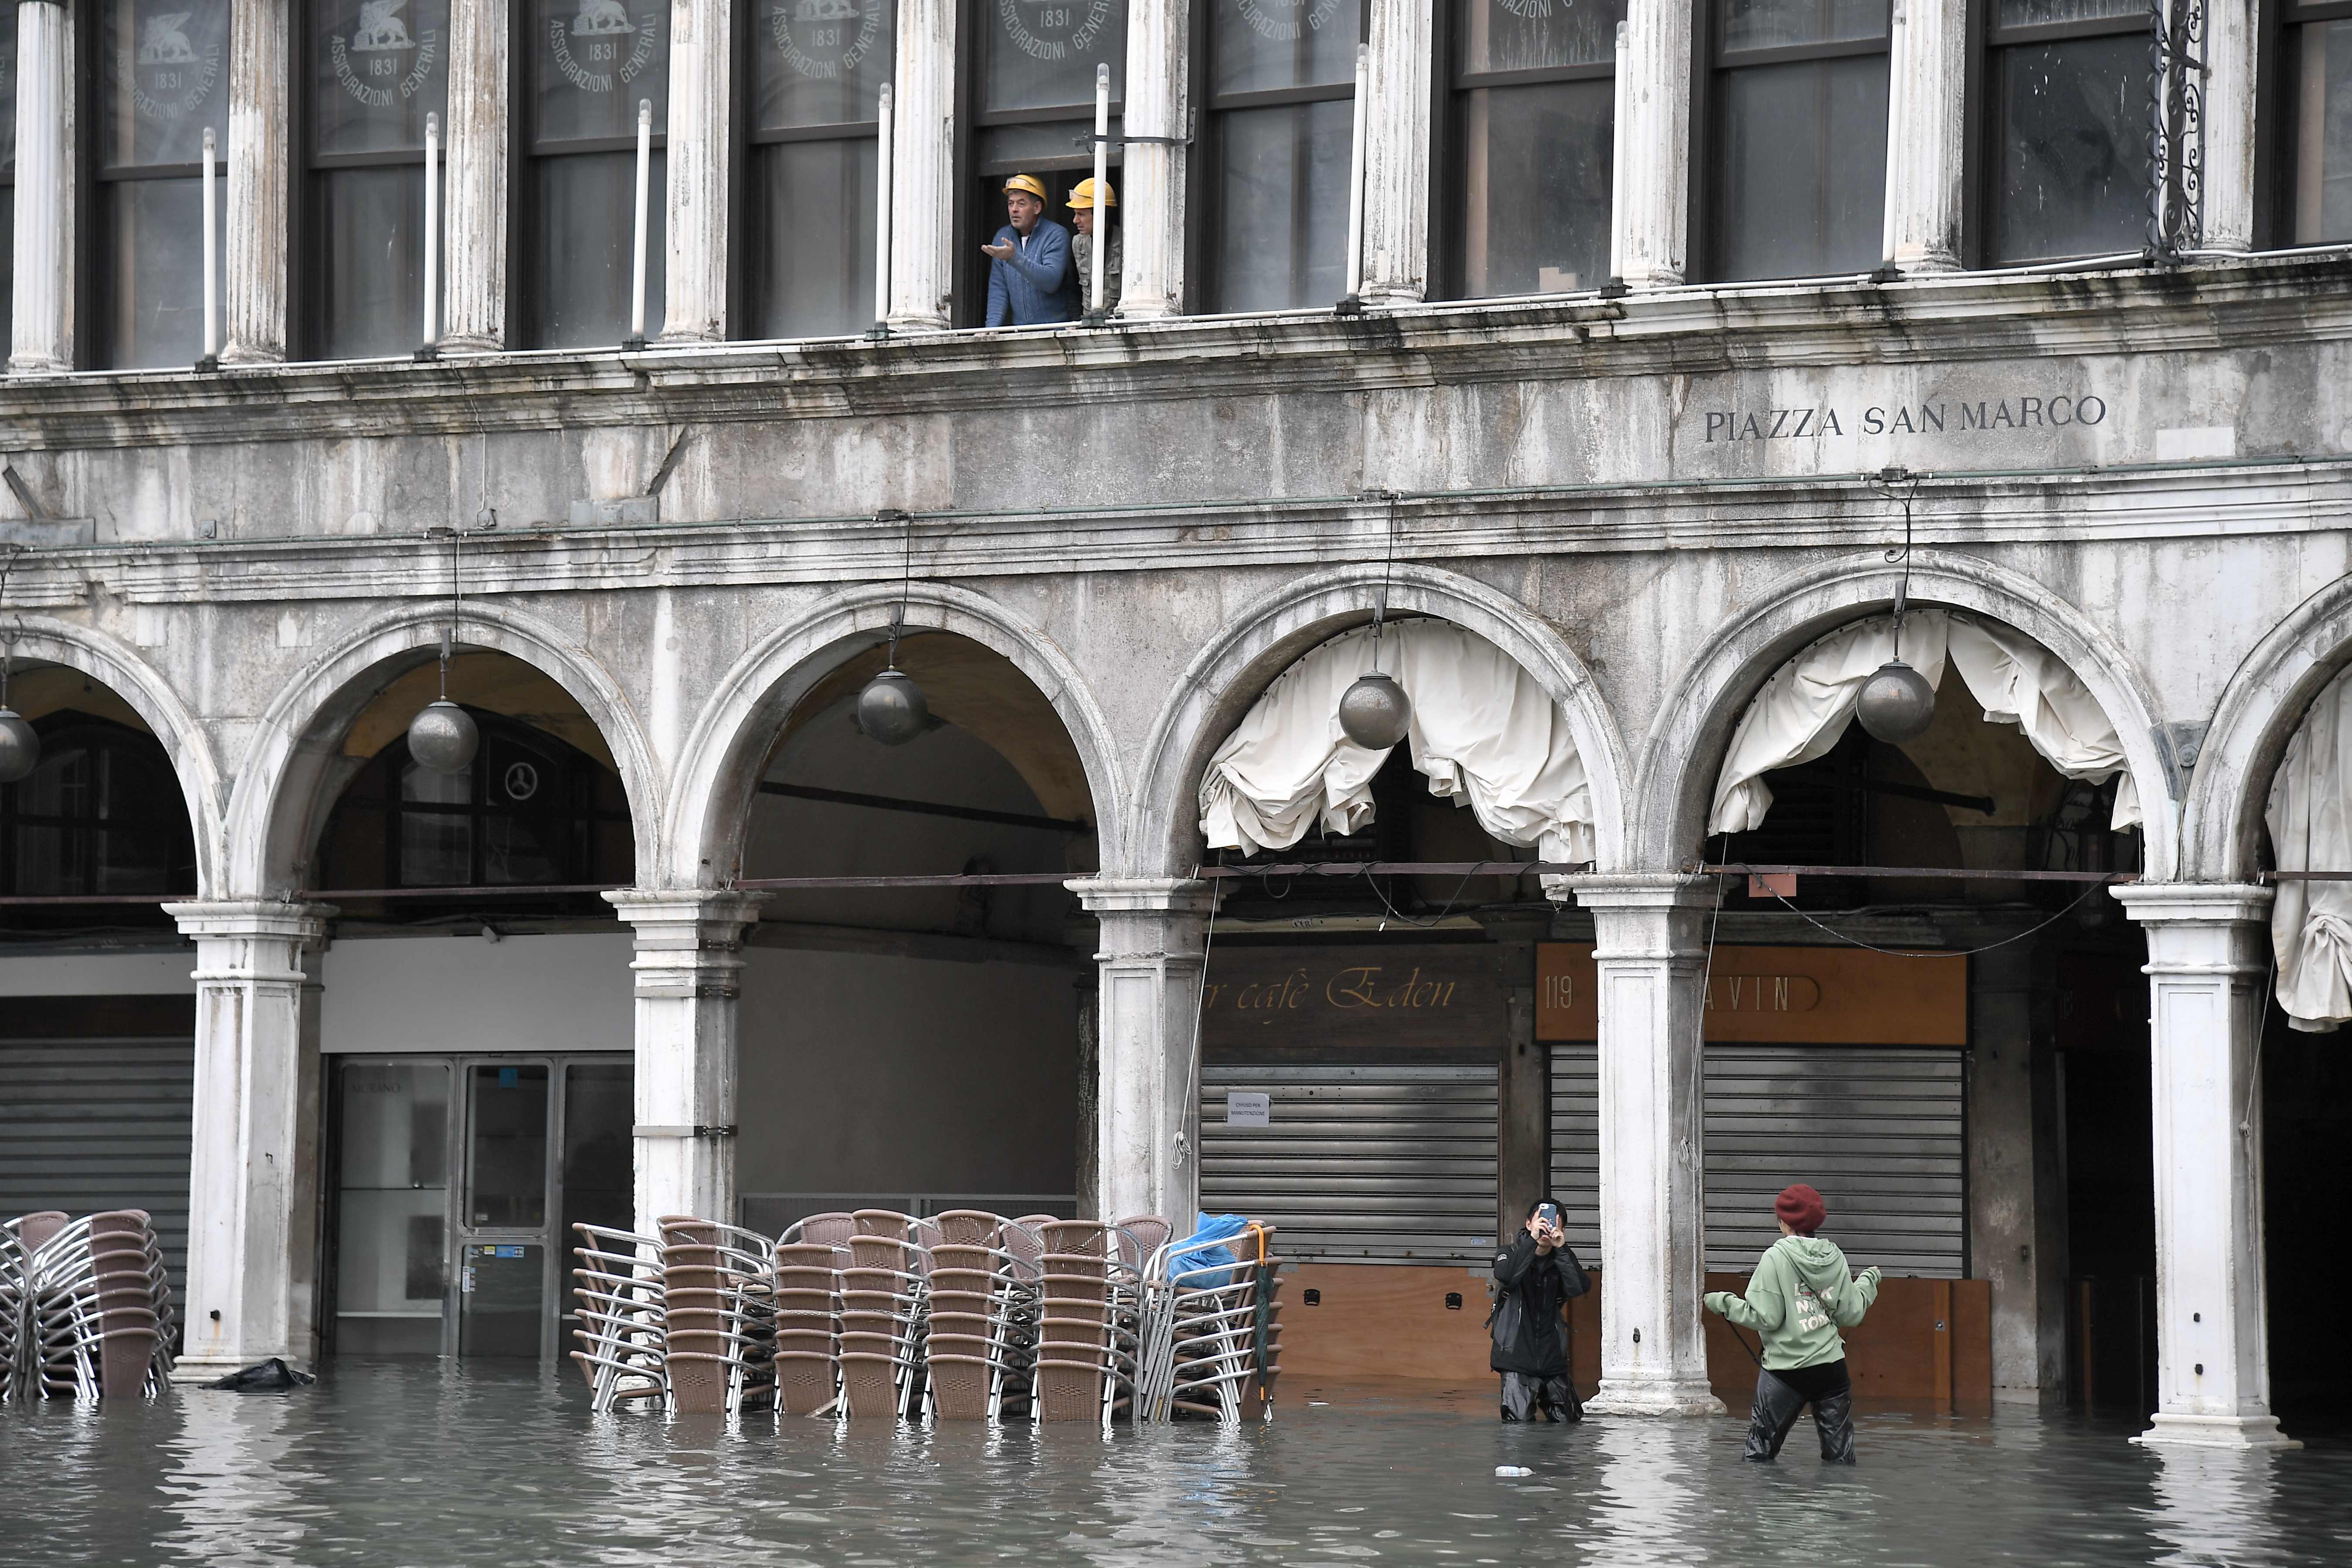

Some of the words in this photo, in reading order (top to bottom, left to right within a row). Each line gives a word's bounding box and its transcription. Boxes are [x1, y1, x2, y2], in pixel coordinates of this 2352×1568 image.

[1041, 8, 1069, 27] 1831
[550, 20, 613, 92] ASSICURAZIONI
[619, 14, 656, 83] GENERALI
[589, 43, 617, 61] 1831
[773, 6, 836, 78] ASSICURAZIONI
[813, 29, 840, 47] 1831
[155, 71, 181, 88] 1831
[185, 44, 218, 112] GENERALI
[331, 35, 393, 106] ASSICURAZIONI
[400, 29, 436, 98] GENERALI
[370, 58, 397, 76] 1831
[1704, 408, 1844, 442] PIAZZA
[1863, 403, 1946, 435] SAN
[1960, 395, 2107, 431] MARCO
[1326, 967, 1456, 1008] Eden
[1544, 975, 1573, 1009] 119
